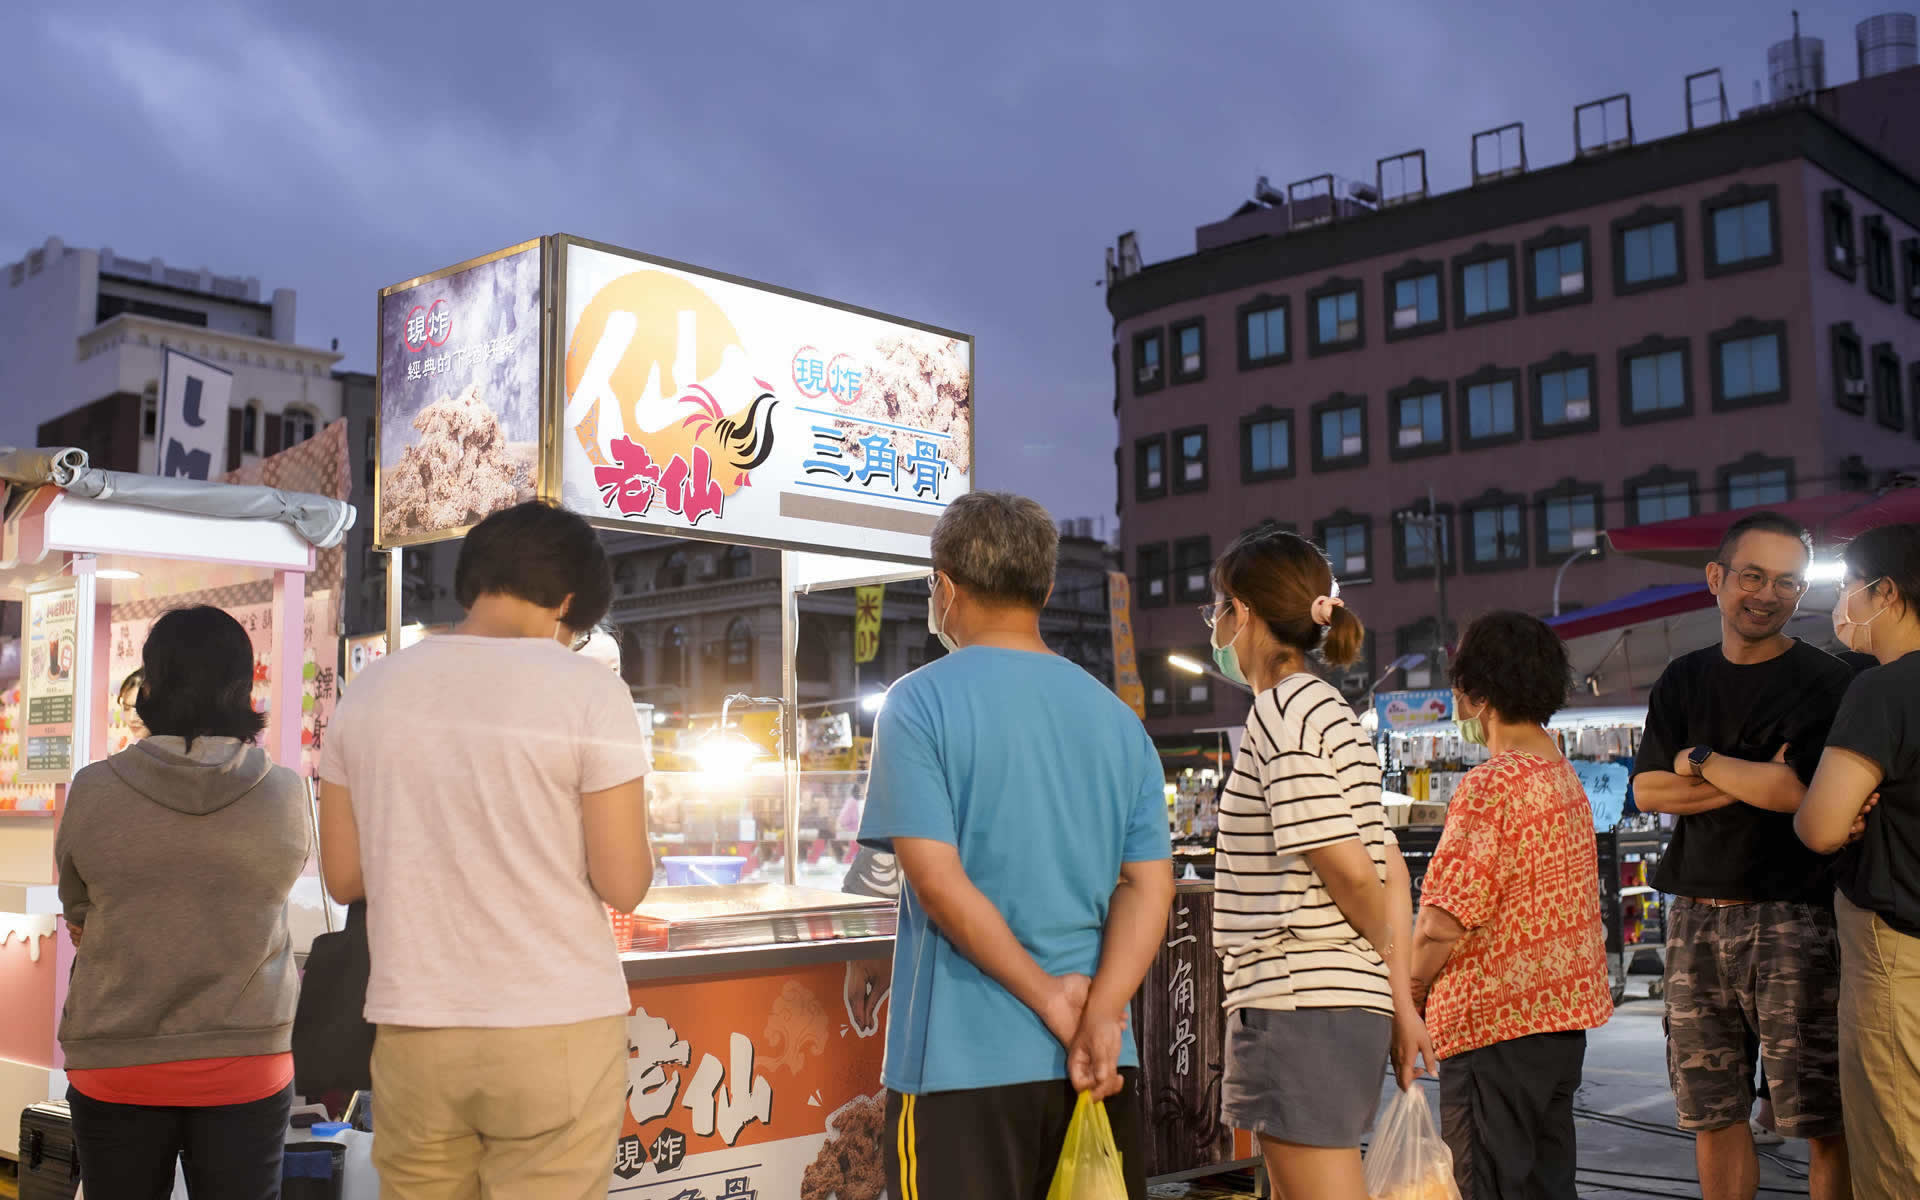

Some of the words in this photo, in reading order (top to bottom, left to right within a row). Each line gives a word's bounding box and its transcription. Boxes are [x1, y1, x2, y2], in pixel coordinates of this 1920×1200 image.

[407, 311, 449, 343] 現炸
[796, 358, 862, 399] 現炸
[594, 434, 725, 526] 老仙
[803, 426, 947, 499] 三角骨
[1167, 907, 1198, 1076] 三角骨
[627, 1006, 774, 1147] 老仙
[615, 1134, 684, 1172] 現炸
